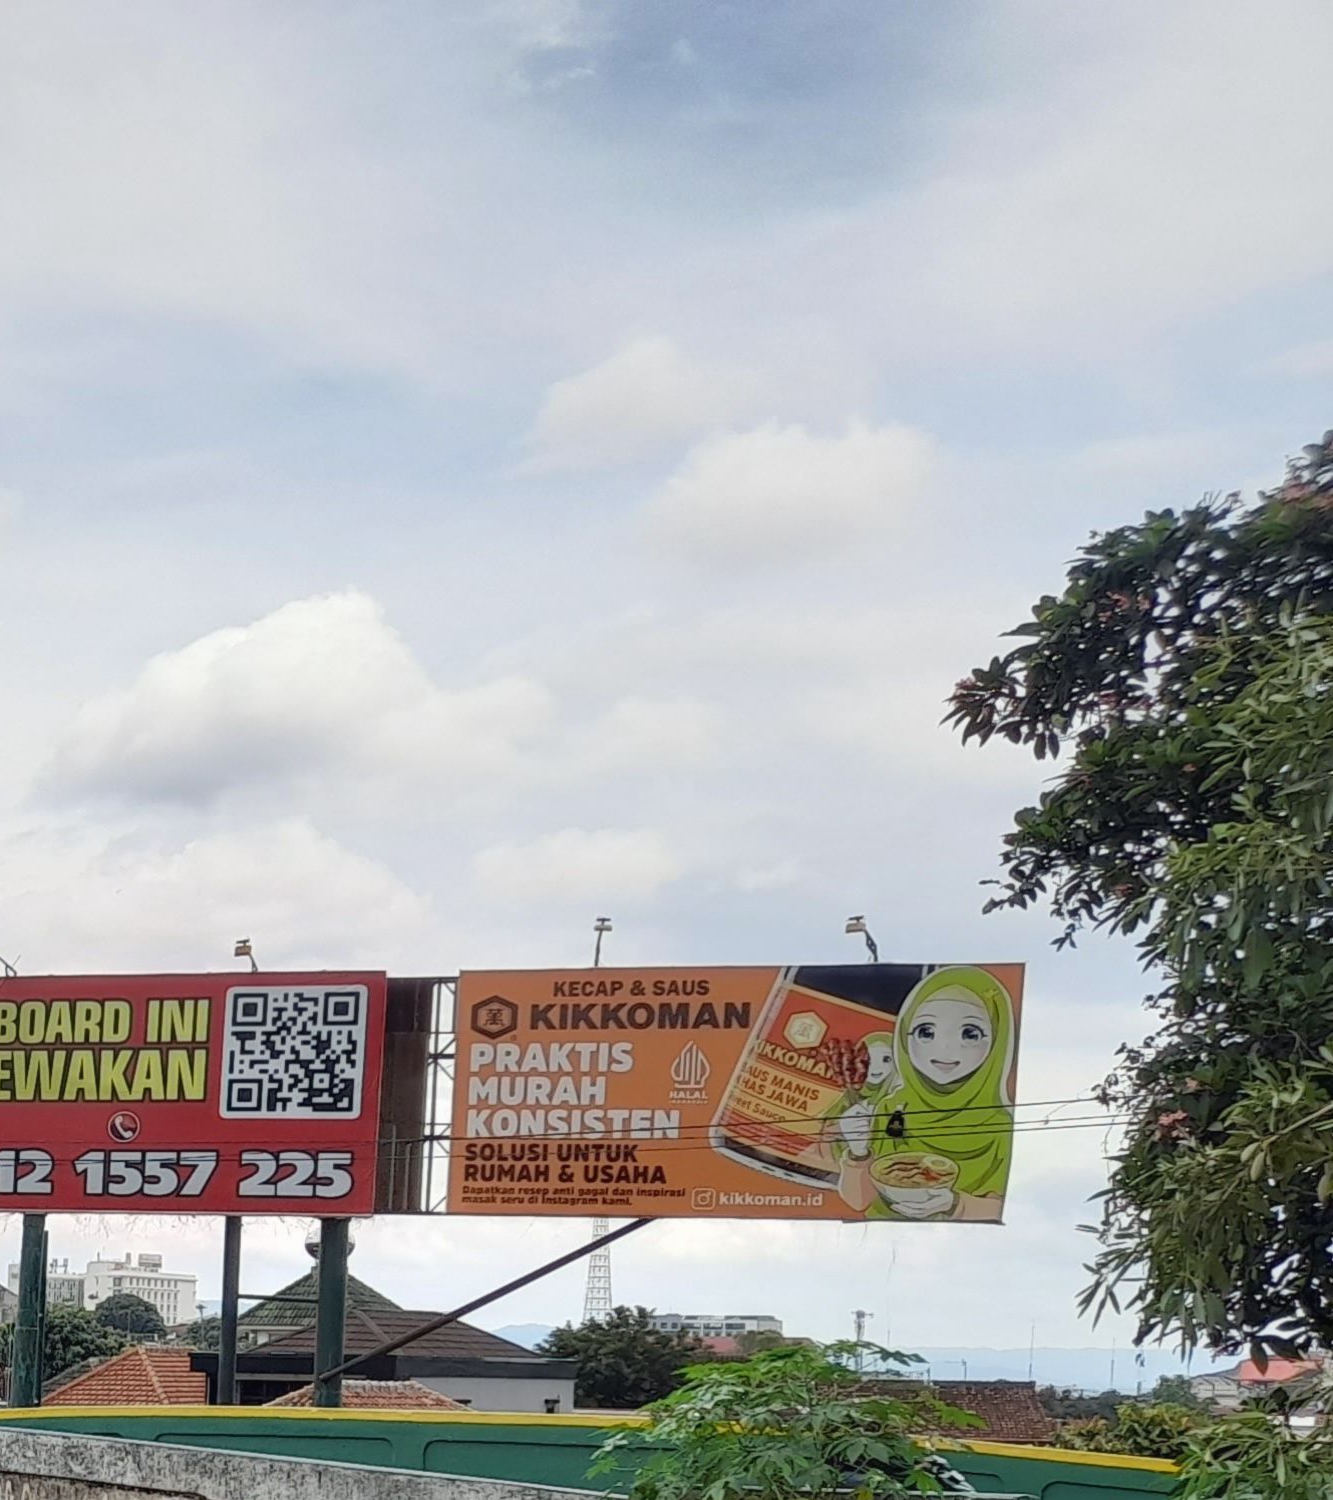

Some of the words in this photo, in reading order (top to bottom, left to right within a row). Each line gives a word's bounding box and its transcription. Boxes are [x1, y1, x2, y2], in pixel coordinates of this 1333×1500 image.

[553, 981, 624, 998] KECAP
[630, 981, 646, 996] &
[652, 980, 710, 996] SAUS
[146, 998, 211, 1044] INI
[529, 1001, 751, 1030] KIKKOMAN
[470, 1042, 634, 1073] PRAKTIS
[467, 1075, 606, 1106] MURAH
[669, 1090, 709, 1099] HALAL
[771, 1075, 820, 1101] MANIS
[766, 1090, 808, 1112] JAWA
[466, 1109, 680, 1139] KONSISTEN
[464, 1143, 548, 1162] SOLUSI
[556, 1144, 638, 1162] UNTUK
[75, 1149, 219, 1197] 1557
[237, 1150, 354, 1198] 225
[464, 1164, 549, 1182] RUMAH
[558, 1164, 574, 1183] &
[583, 1165, 667, 1184] USAHA
[462, 1185, 515, 1195] Dapatkan
[518, 1187, 550, 1196] resep
[552, 1187, 574, 1195] anti
[578, 1187, 609, 1196] gagal
[612, 1187, 633, 1196] dan
[636, 1187, 686, 1197] inspirasi
[462, 1195, 497, 1204] masak
[527, 1196, 539, 1204] di
[719, 1192, 823, 1207] kikkoman.id
